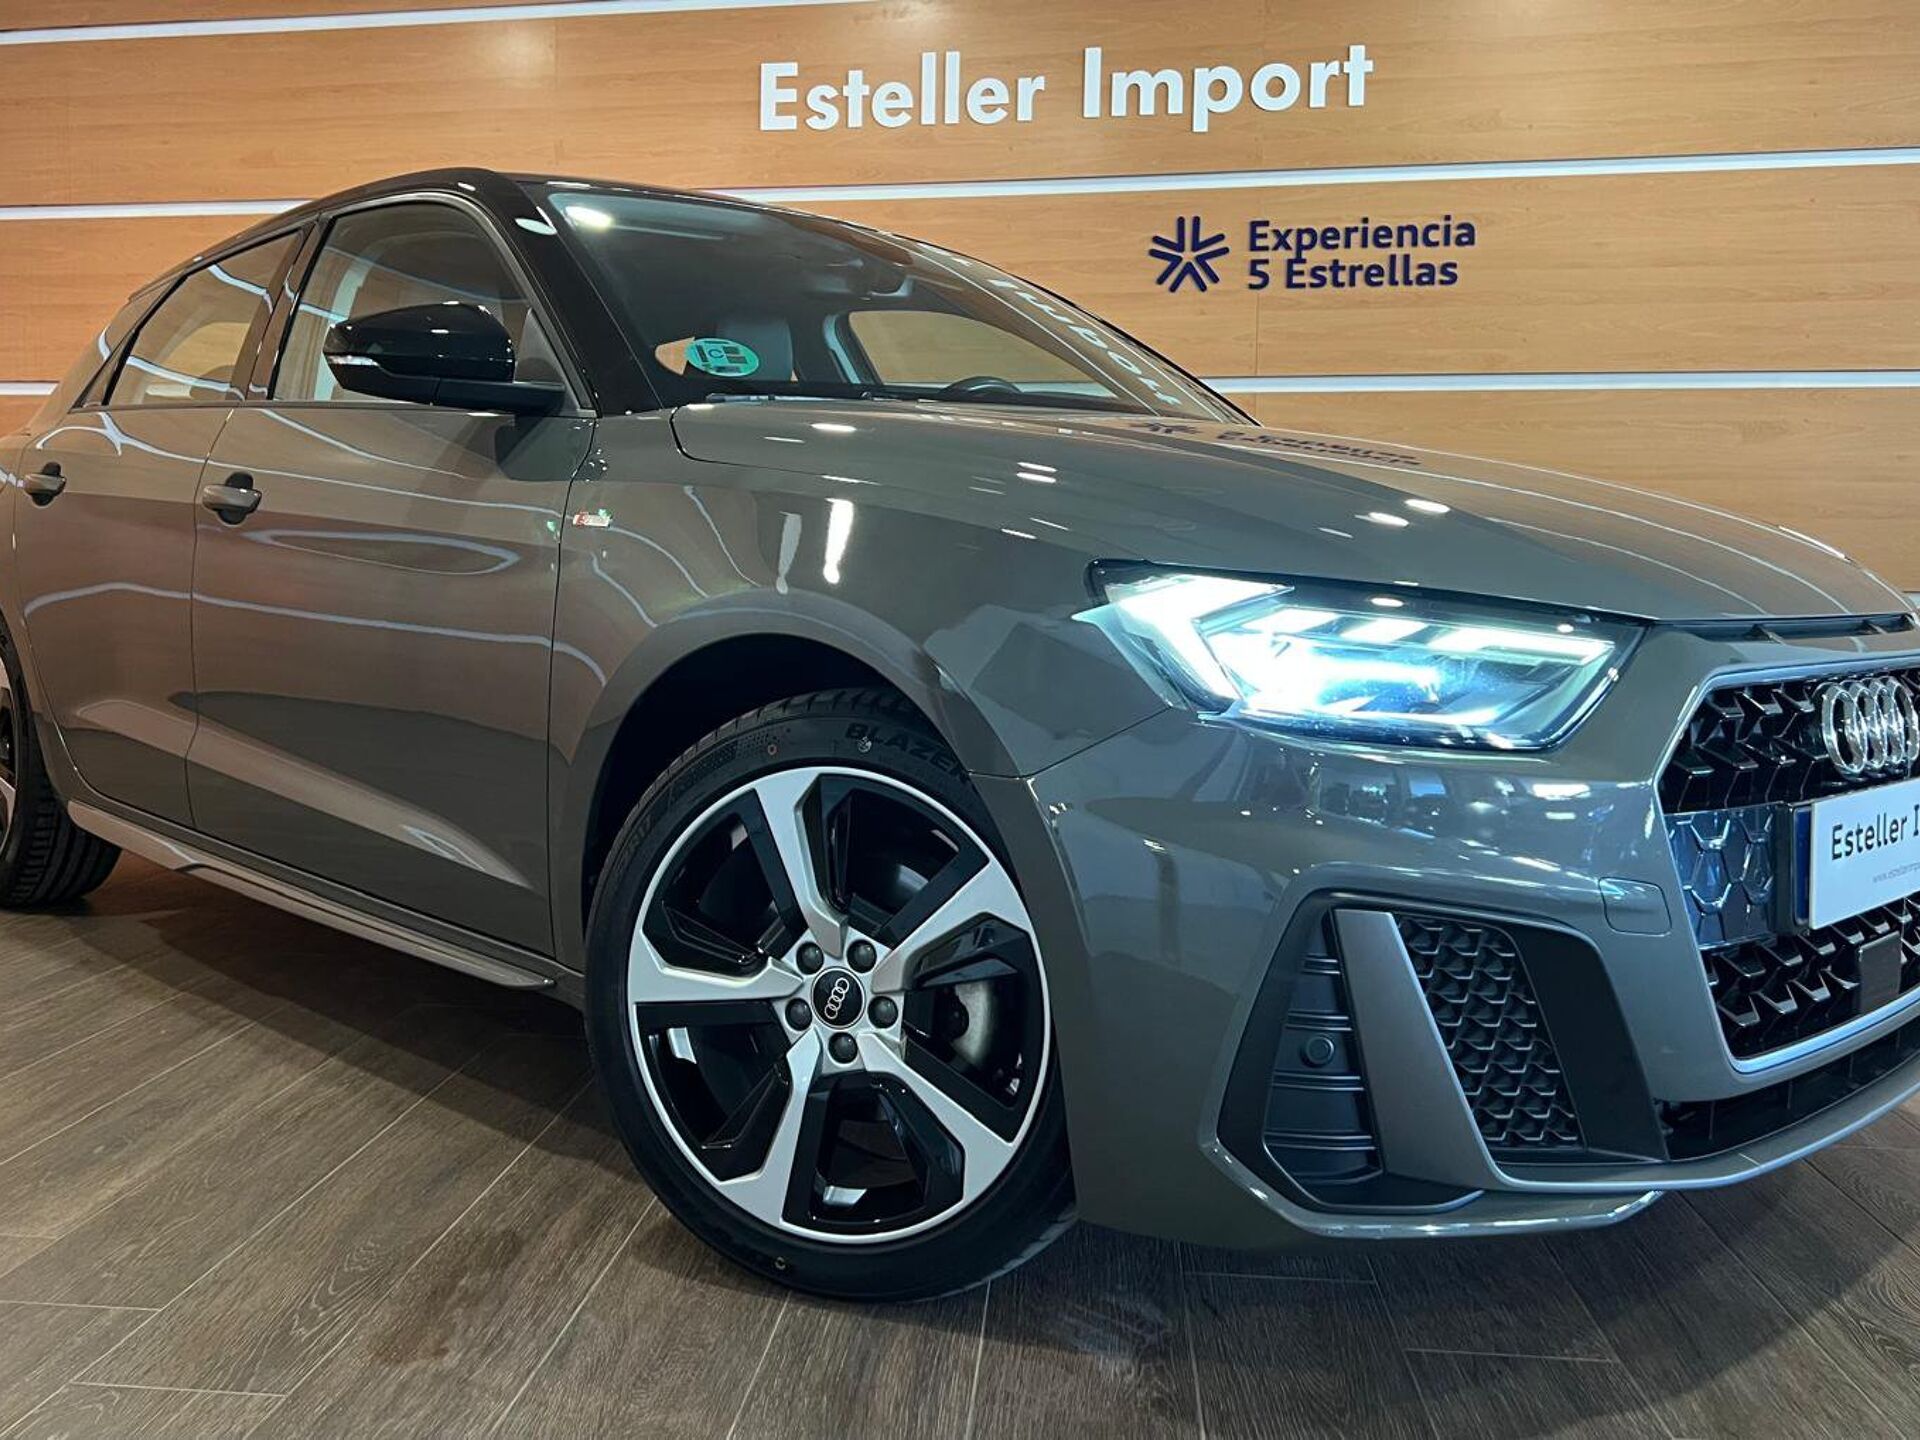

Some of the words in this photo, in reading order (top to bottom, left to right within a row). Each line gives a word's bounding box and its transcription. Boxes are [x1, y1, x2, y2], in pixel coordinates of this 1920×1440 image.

[760, 50, 1046, 132] Esteller
[1083, 44, 1374, 133] Import
[1247, 214, 1477, 258] Experiencia
[1247, 258, 1270, 291] 5
[1285, 253, 1459, 290] Estrellas
[1831, 811, 1908, 861] Esteller
